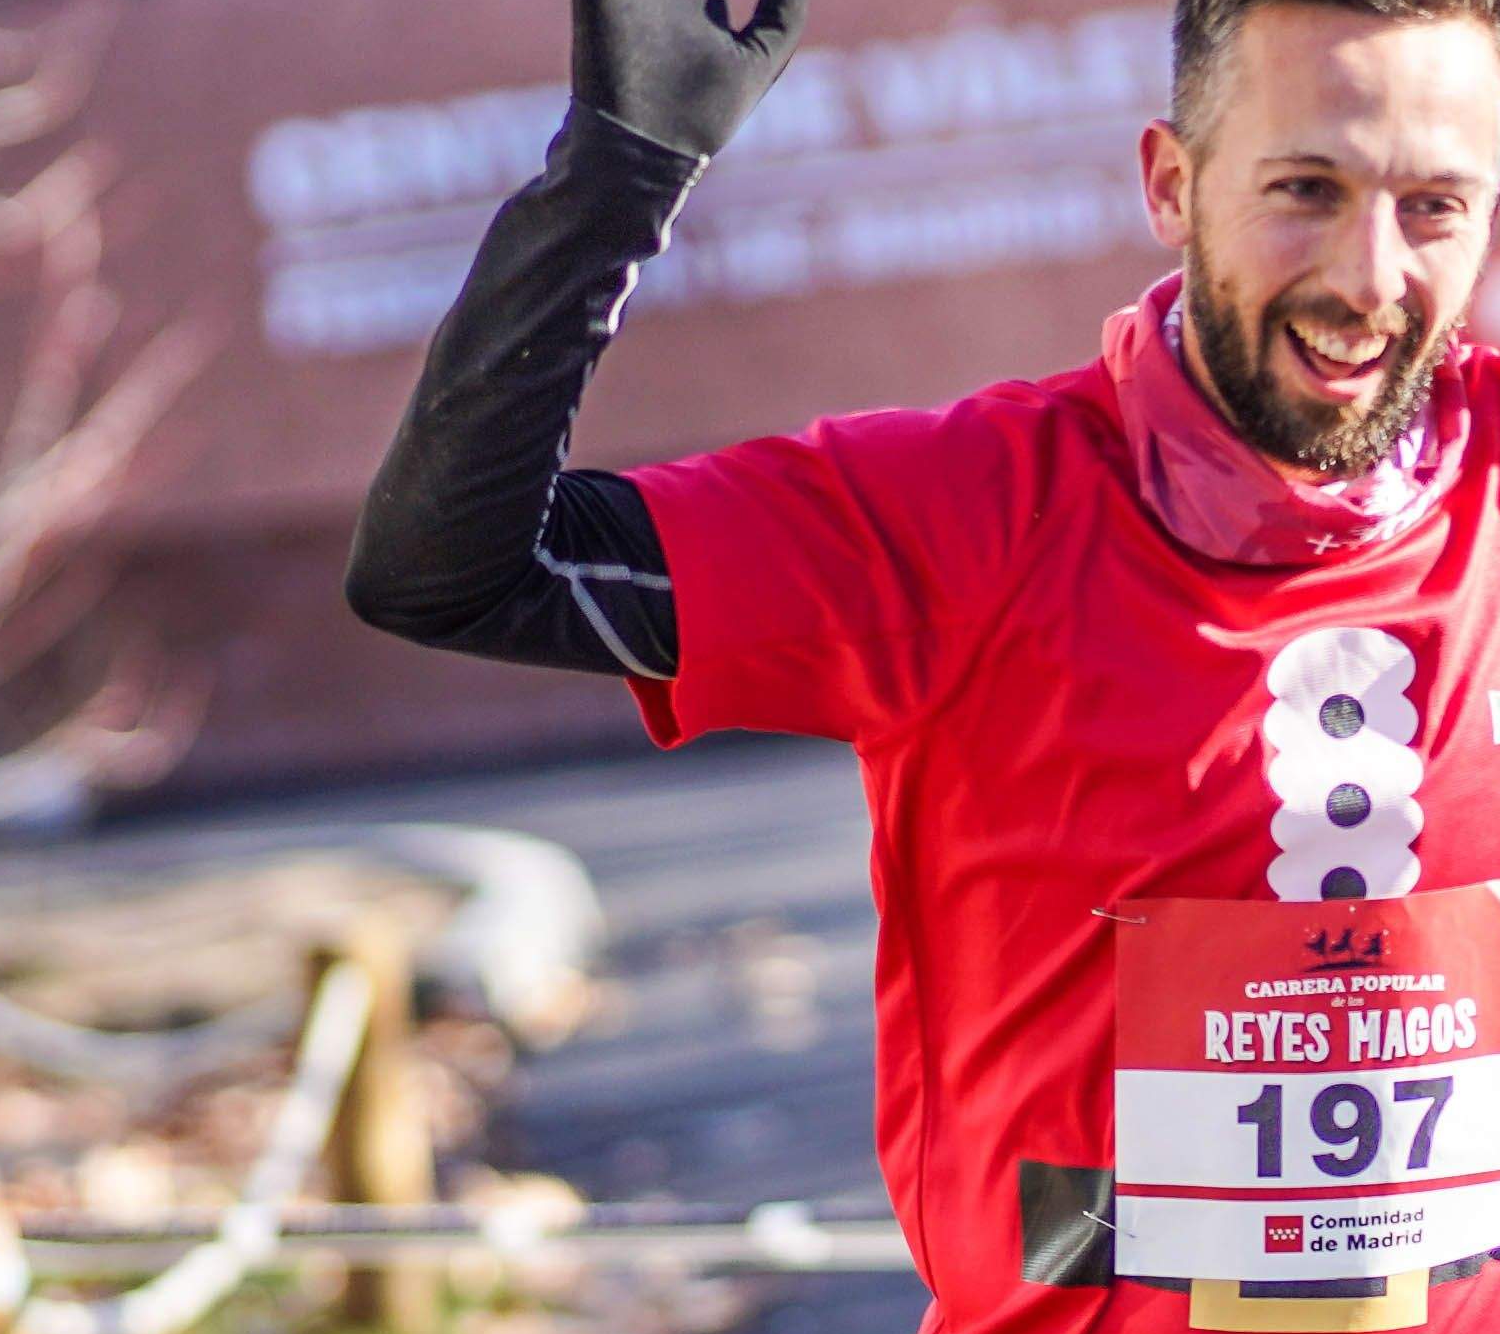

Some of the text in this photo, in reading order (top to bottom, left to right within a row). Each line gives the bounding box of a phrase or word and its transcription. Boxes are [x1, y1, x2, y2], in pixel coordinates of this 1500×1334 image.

[1244, 974, 1445, 999] CARRERA POPULAR
[1330, 996, 1346, 1008] de
[1204, 998, 1477, 1063] REYES MAGOS
[1237, 1075, 1454, 1178] 197
[1310, 1208, 1424, 1230] Comunidad
[1310, 1229, 1423, 1253] de Madrid
